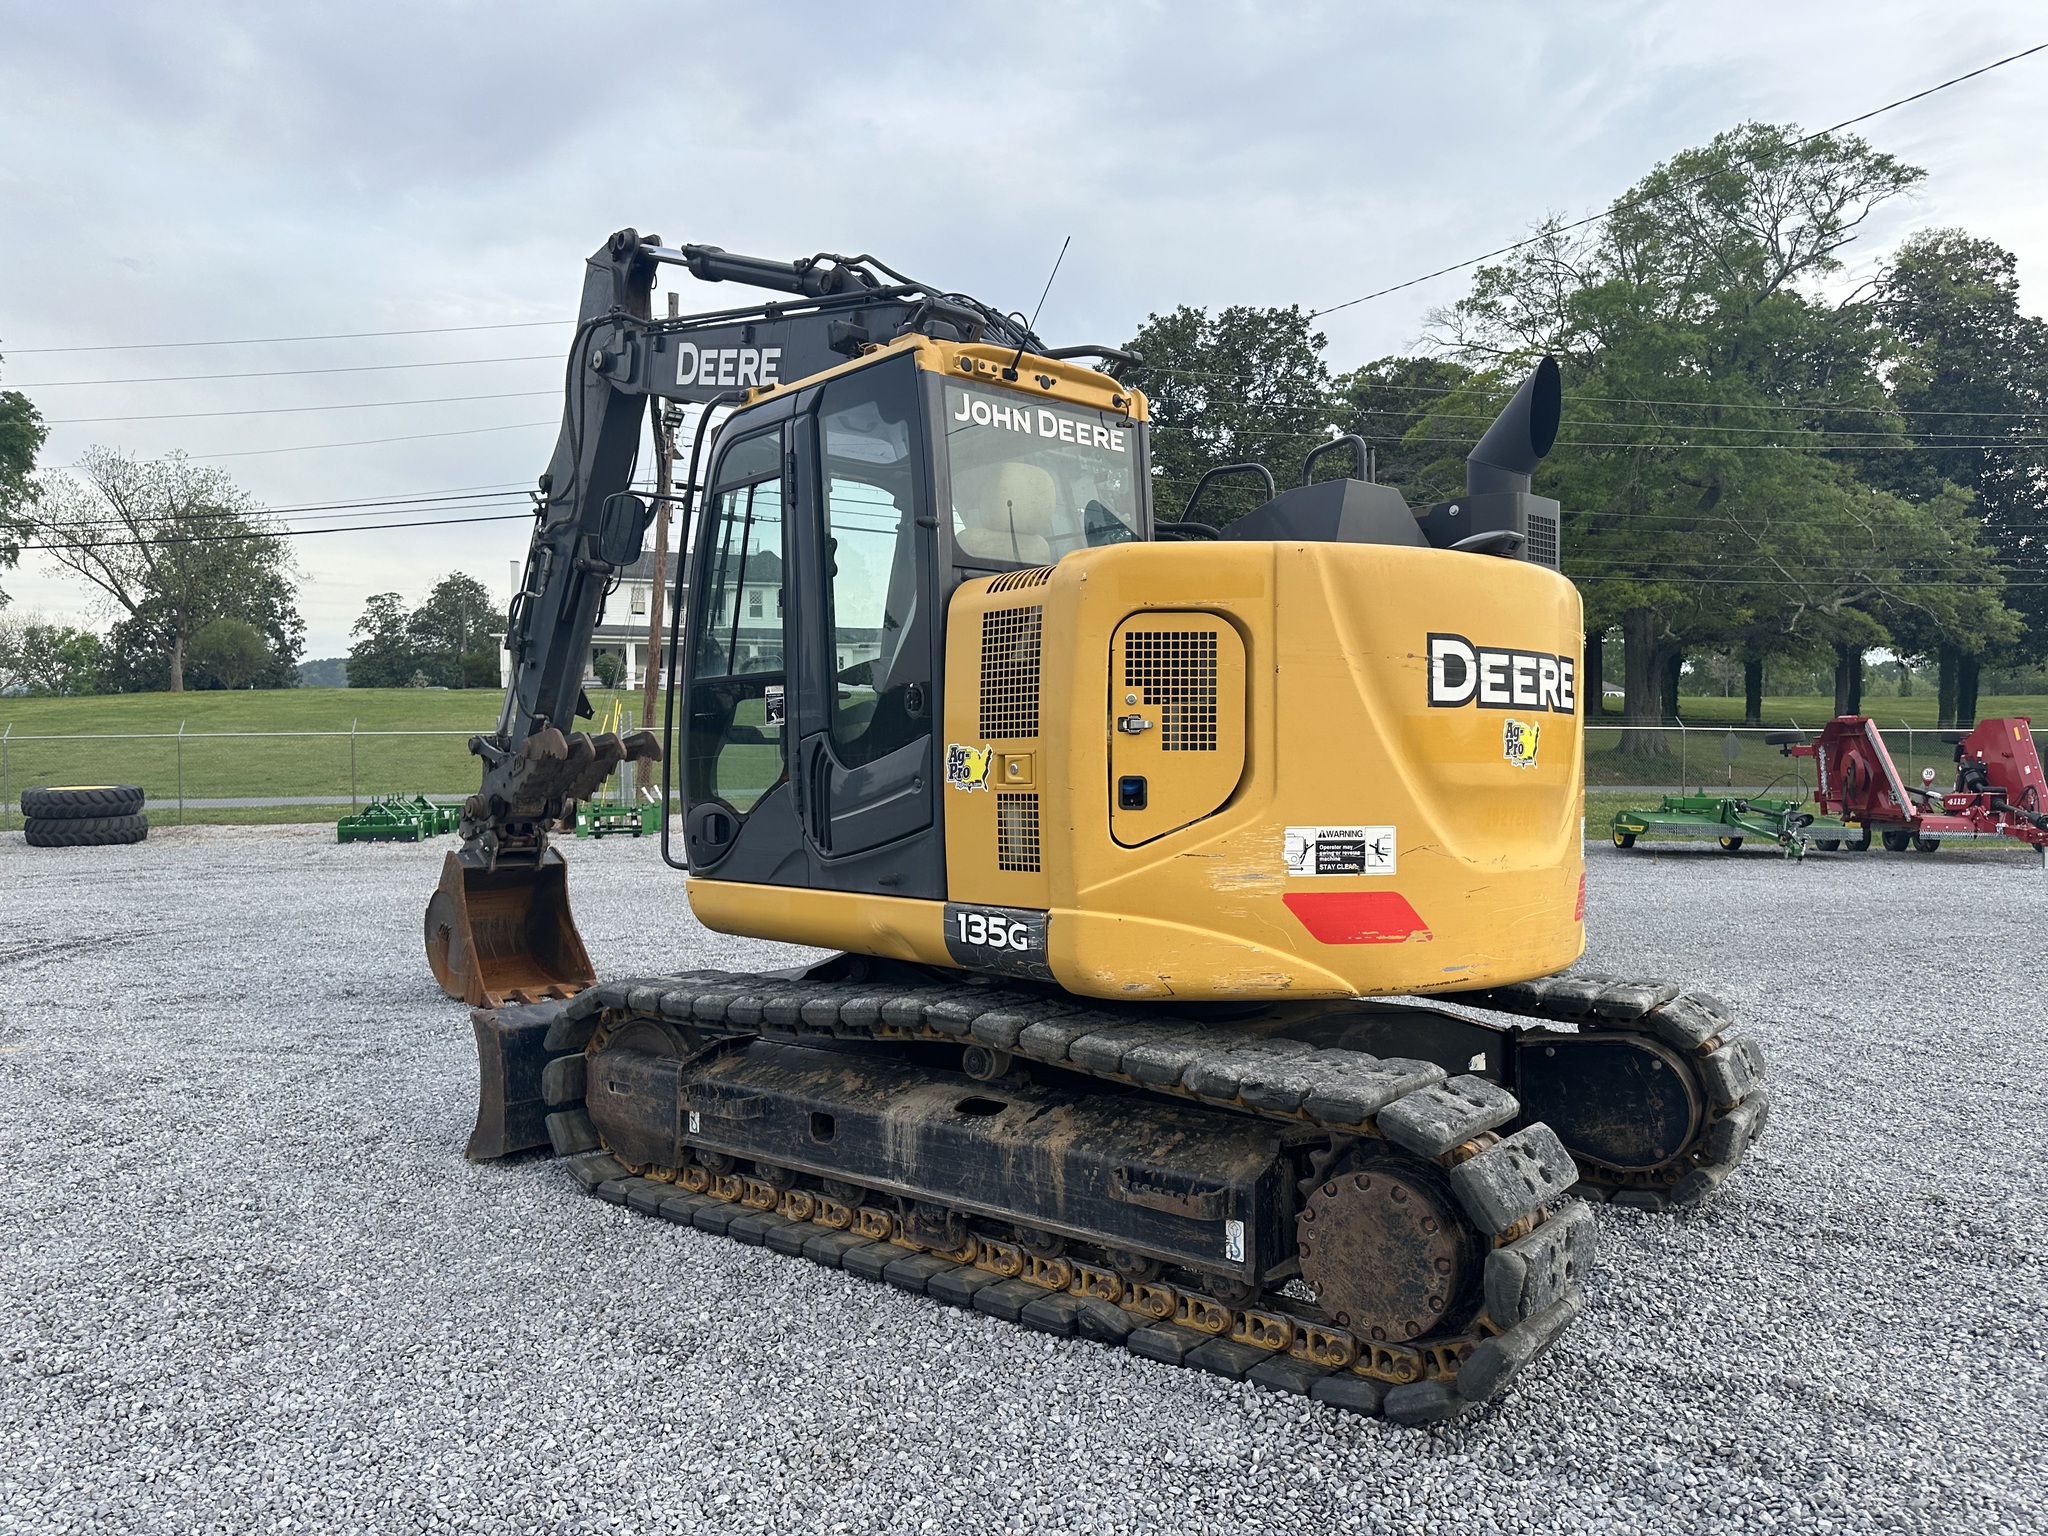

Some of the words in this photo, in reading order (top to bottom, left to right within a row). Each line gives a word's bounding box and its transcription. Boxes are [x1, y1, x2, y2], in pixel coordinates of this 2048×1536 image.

[676, 342, 782, 386] DEERE
[954, 393, 1032, 434] JOHN
[1037, 409, 1125, 452] DEERE
[1431, 639, 1574, 709] DEERE
[1505, 722, 1524, 742] Ag-
[948, 746, 970, 766] Ag-
[1505, 738, 1524, 756] Pro
[948, 763, 970, 780] Pro
[1326, 830, 1363, 838] WARNING
[957, 913, 1028, 951] 135G
